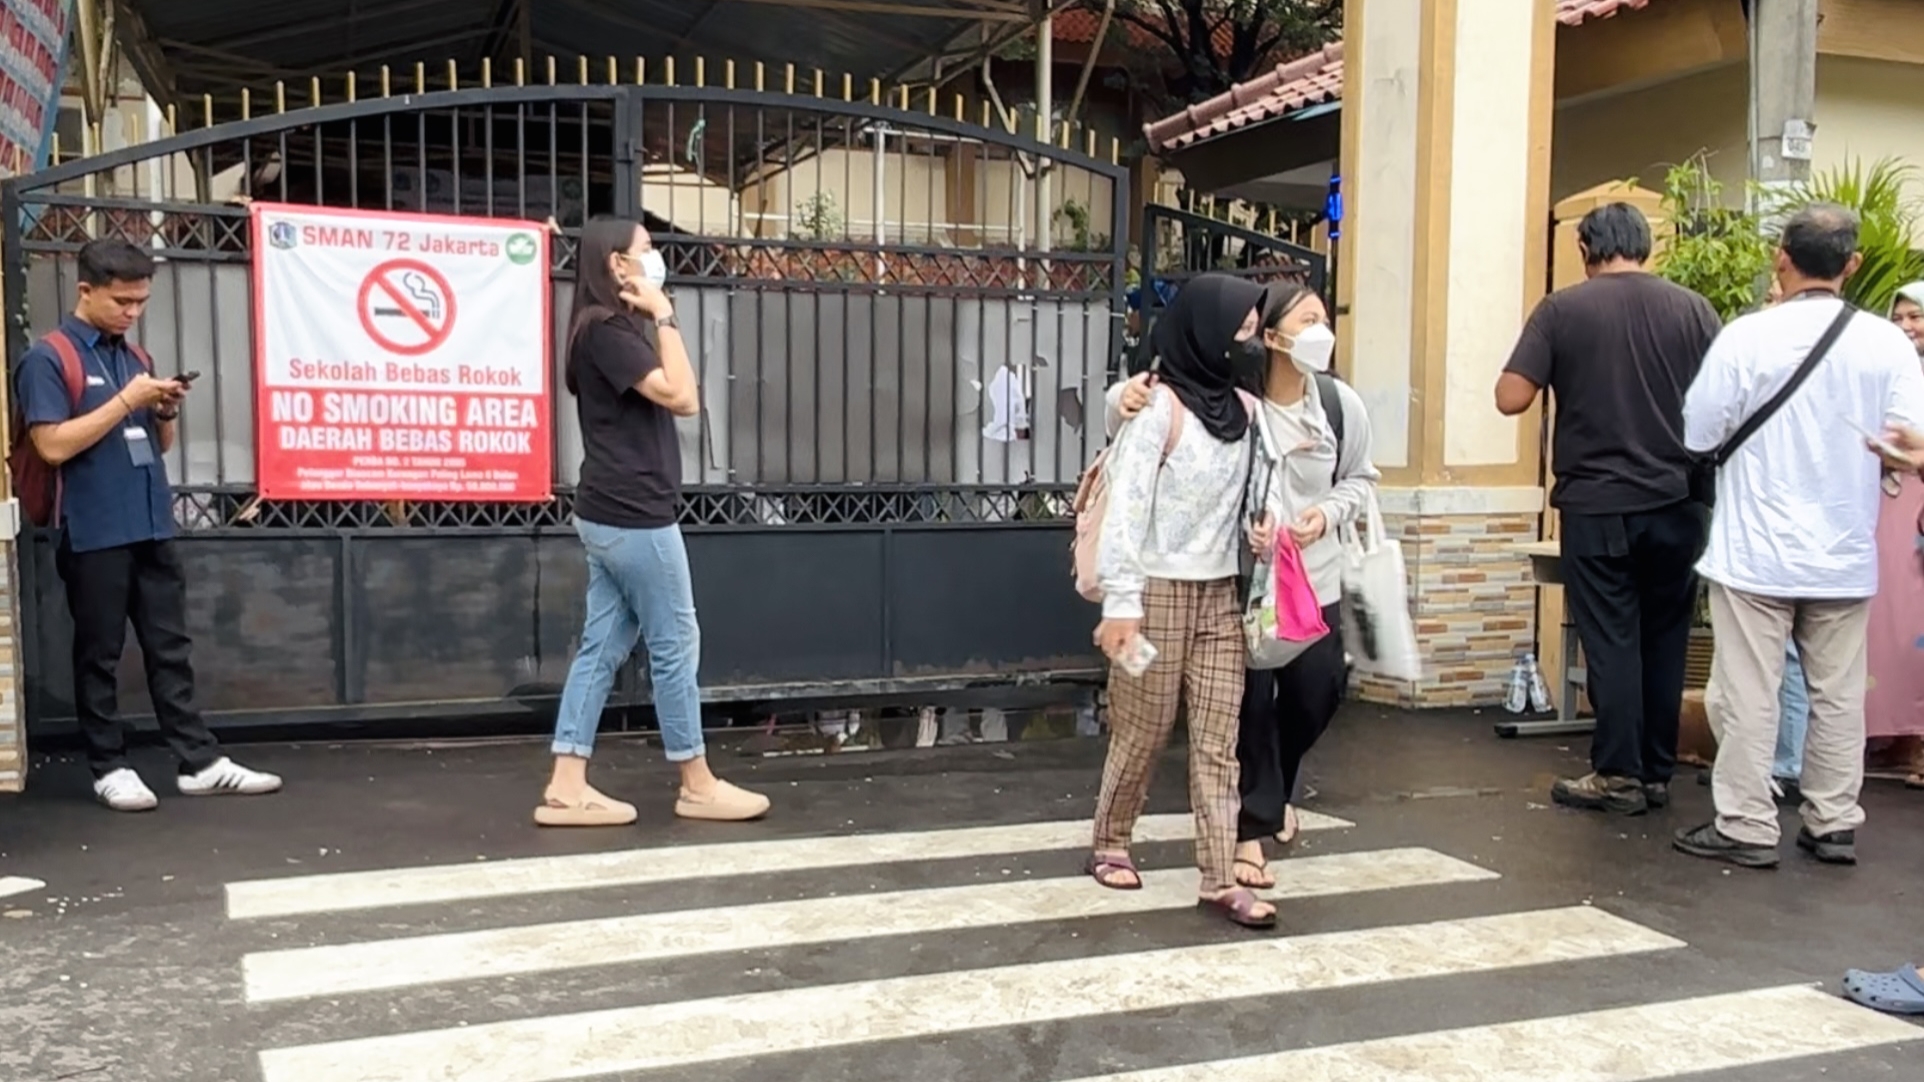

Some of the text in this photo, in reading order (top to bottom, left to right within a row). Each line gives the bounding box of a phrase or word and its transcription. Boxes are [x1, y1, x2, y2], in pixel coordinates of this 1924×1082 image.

[302, 225, 500, 257] SMAN 72 Jakarta
[289, 358, 522, 386] Sekolah Bebas Rokok
[271, 391, 538, 428] NO SMOKING AREA
[280, 425, 532, 453] DAERAH BEBAS ROKOK
